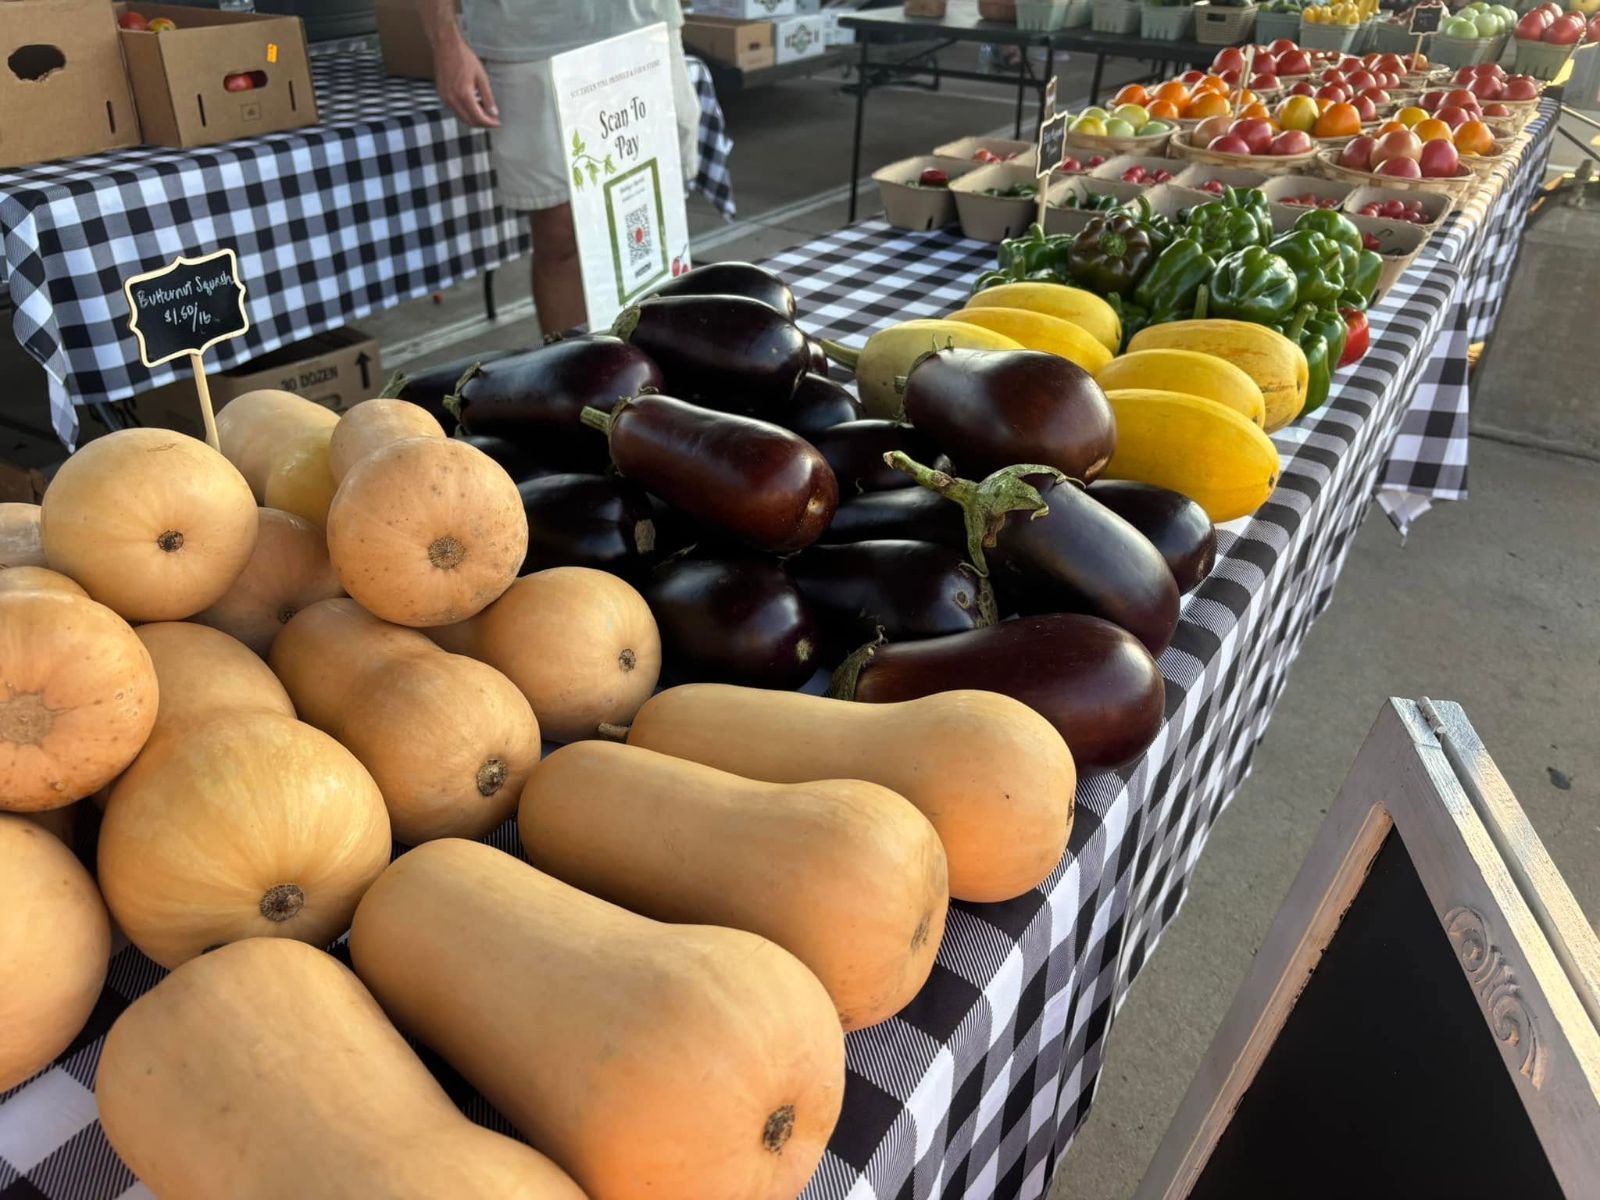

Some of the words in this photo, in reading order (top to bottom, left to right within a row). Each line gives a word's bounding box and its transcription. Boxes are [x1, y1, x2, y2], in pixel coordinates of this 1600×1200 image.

[600, 109, 629, 139] Scan
[630, 96, 646, 121] To
[614, 135, 639, 161] Pay
[195, 270, 233, 296] Squash
[300, 366, 338, 388] DOZEN
